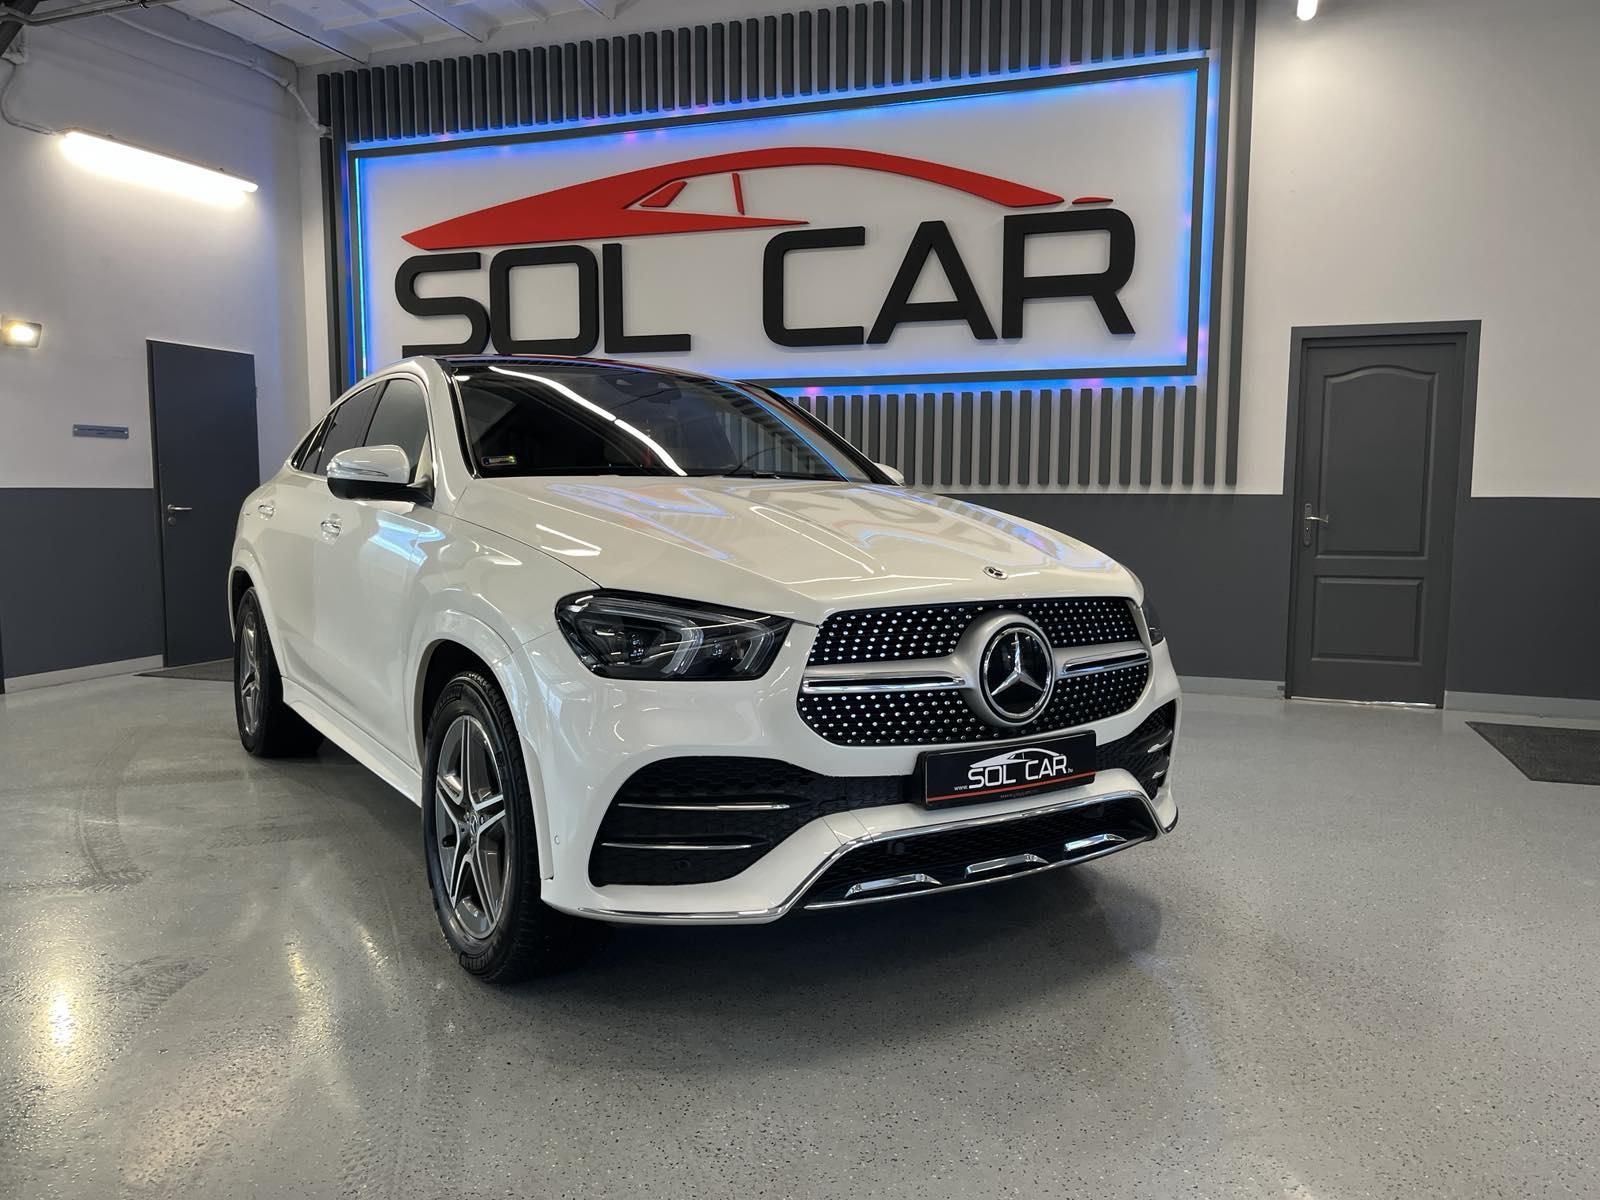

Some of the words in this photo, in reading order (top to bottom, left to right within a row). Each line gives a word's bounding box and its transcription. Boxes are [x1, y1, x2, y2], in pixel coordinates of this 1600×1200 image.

[395, 243, 691, 357] SOL
[763, 208, 1136, 347] CAR
[968, 765, 1016, 789] SOL
[1025, 755, 1067, 780] CAR
